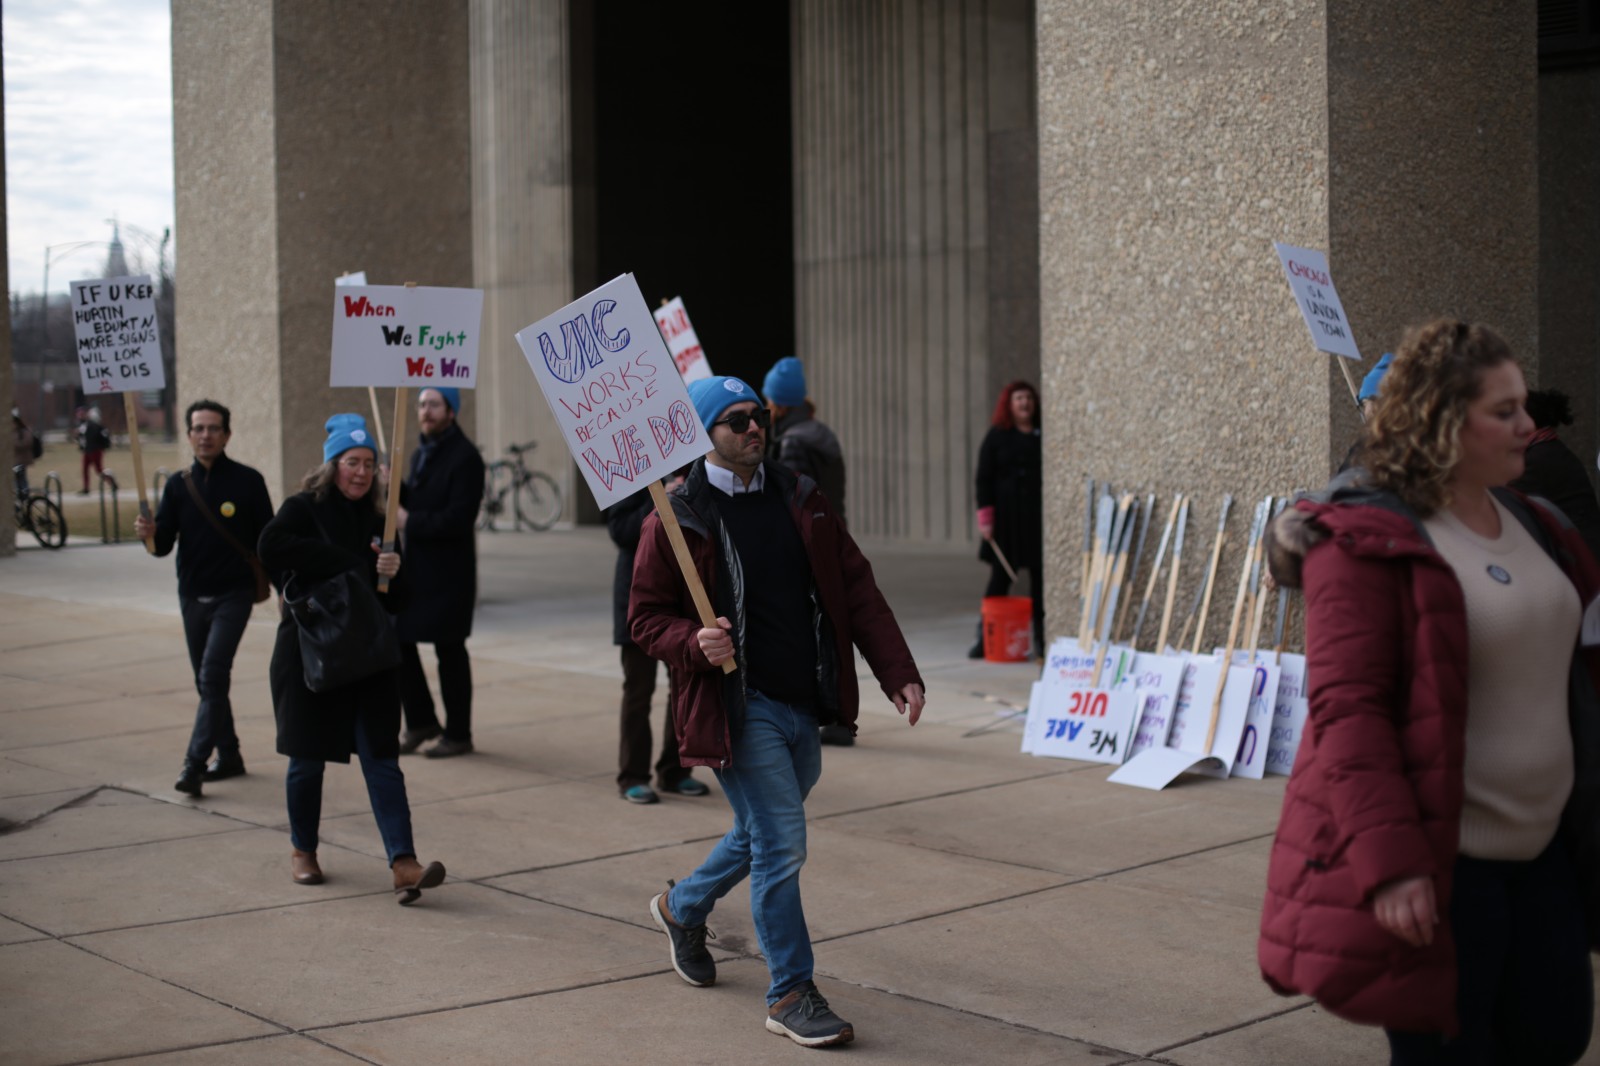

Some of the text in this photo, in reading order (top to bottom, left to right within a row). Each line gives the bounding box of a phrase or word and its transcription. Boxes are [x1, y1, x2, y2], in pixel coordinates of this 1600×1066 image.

[77, 284, 102, 306] IF
[108, 284, 121, 302] U
[343, 295, 396, 318] When
[75, 304, 124, 325] HURTIN
[1306, 298, 1341, 322] UNION
[79, 328, 156, 351] MORE SIGNS
[381, 325, 467, 350] We Fight
[1317, 319, 1346, 339] TOWN
[537, 299, 631, 384] UIC
[81, 346, 142, 365] WIL LOK
[406, 356, 470, 379] We Win
[86, 362, 150, 380] LIK DIS
[559, 350, 657, 419] WORKS
[575, 379, 659, 445] BECAUSE
[581, 399, 697, 492] WE DO
[1068, 691, 1109, 718] UIC
[1044, 718, 1084, 742] ARE
[1089, 730, 1118, 756] WE
